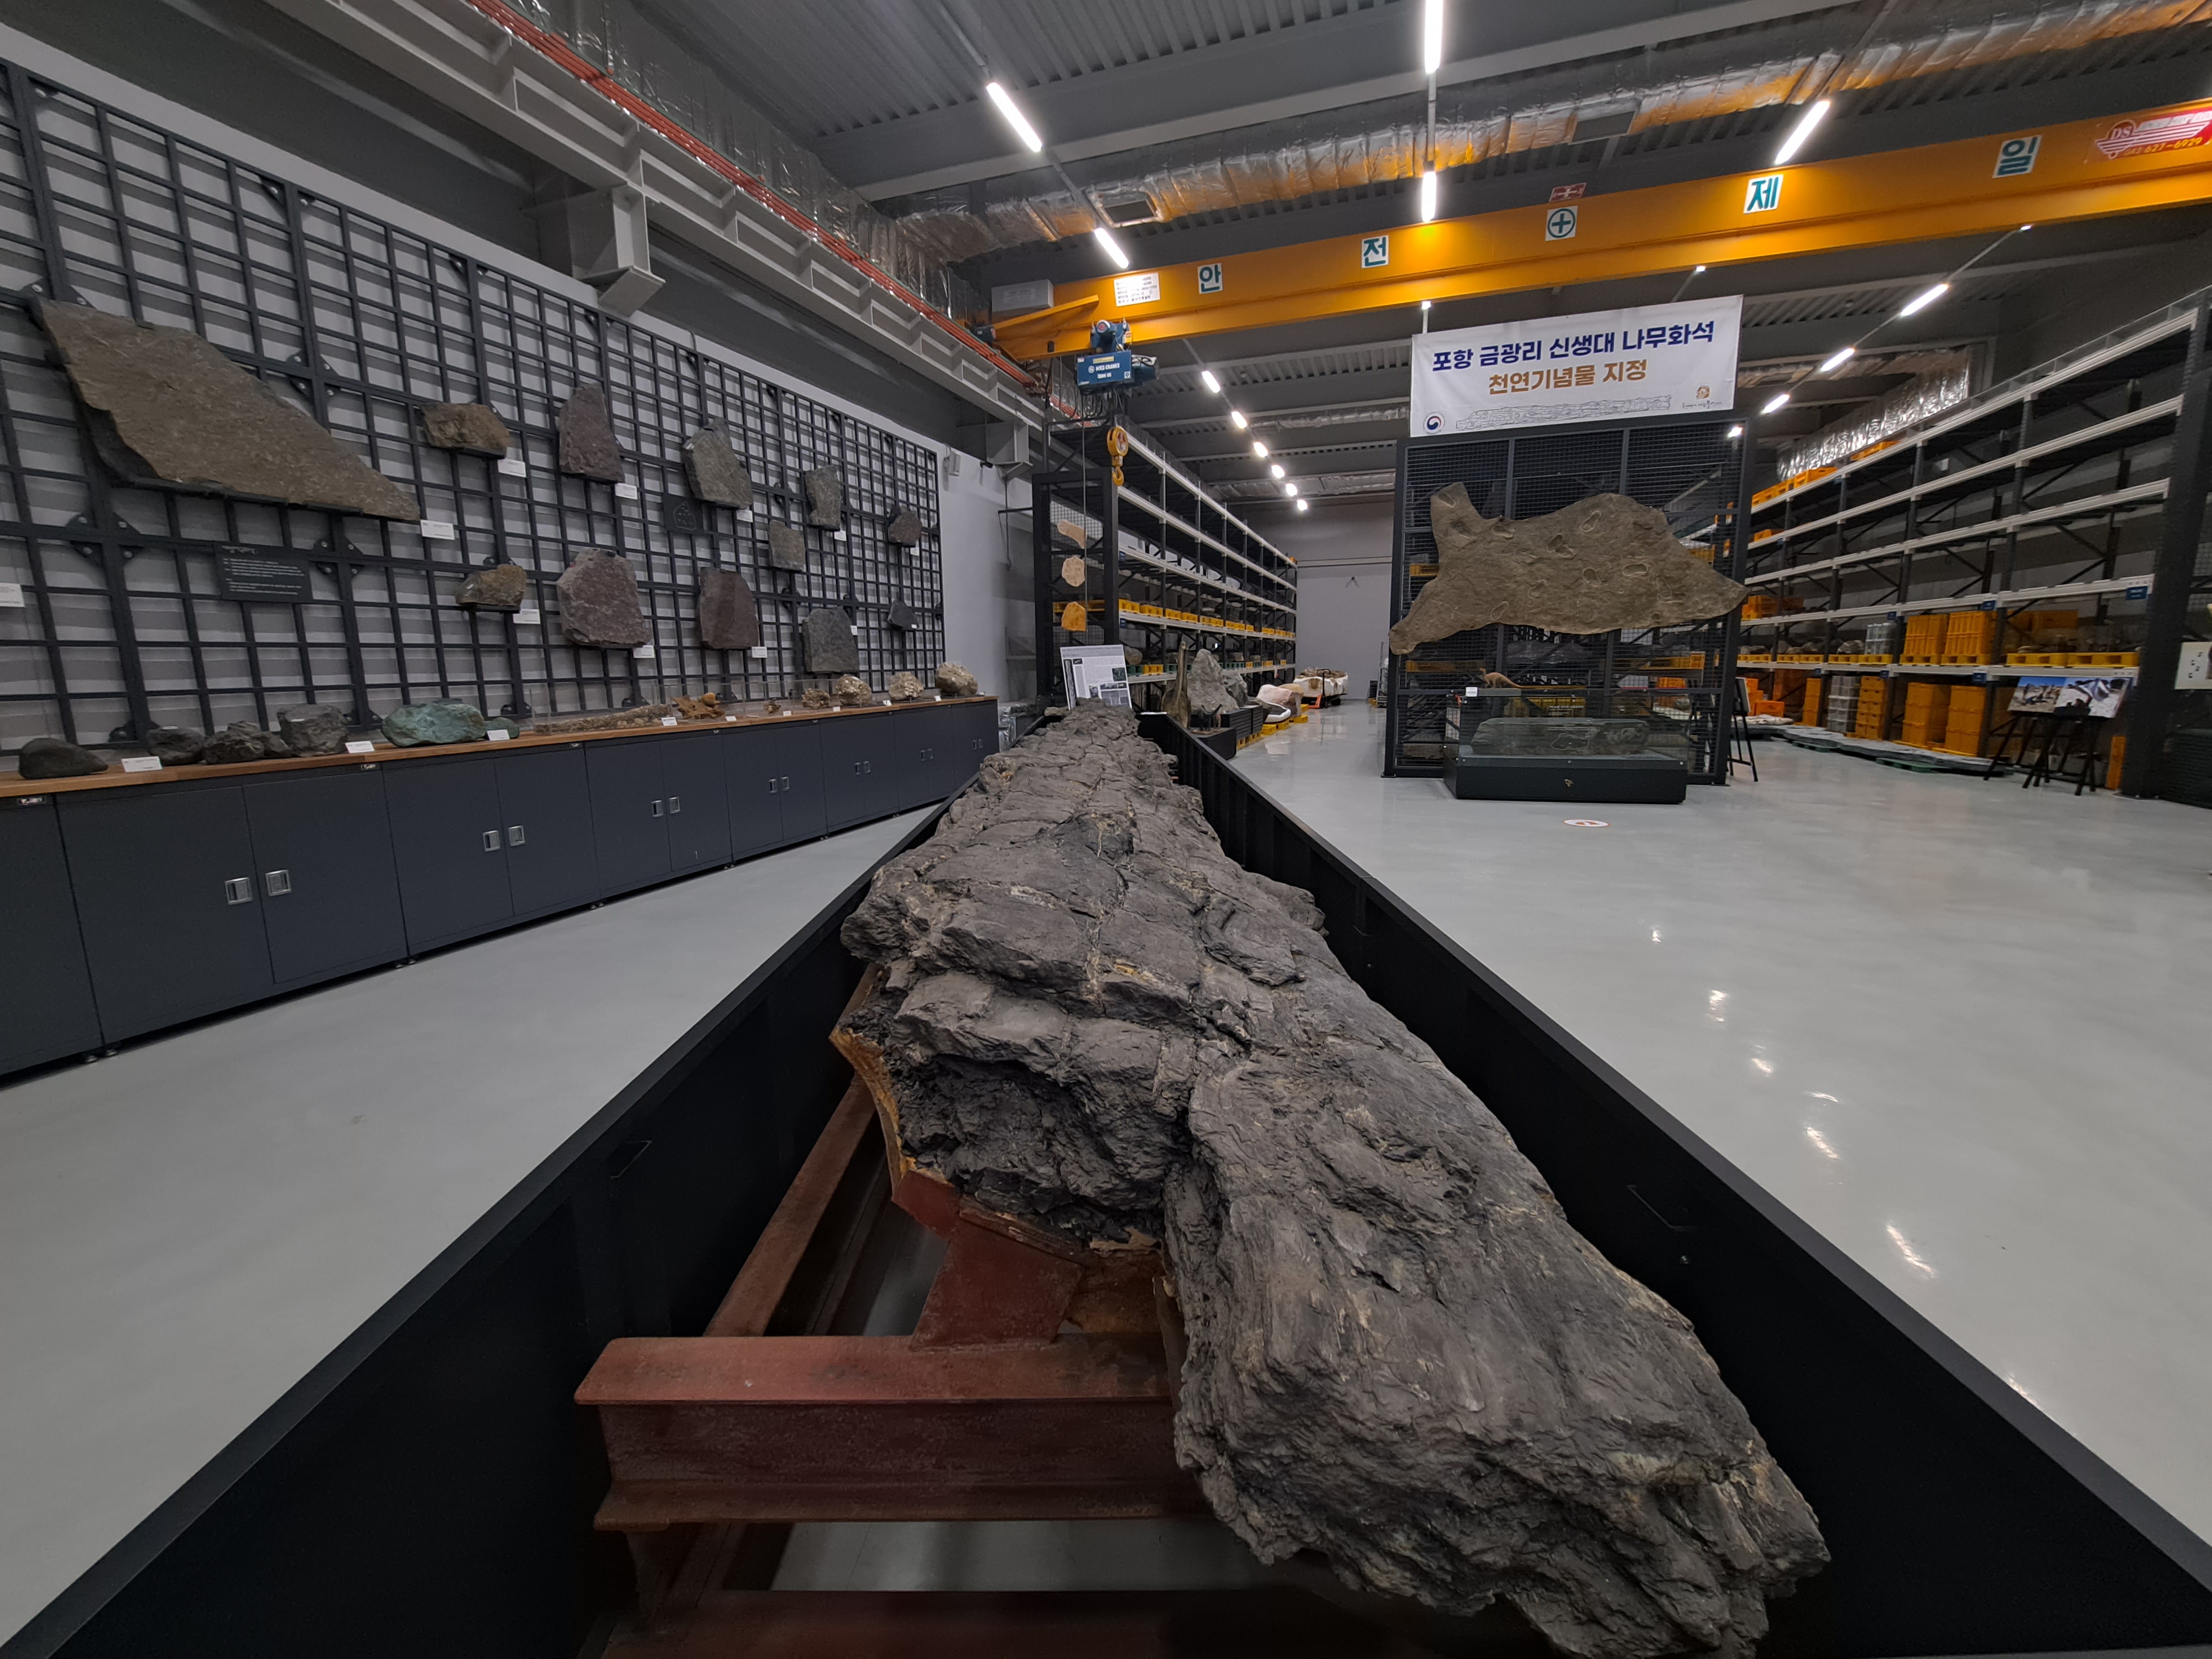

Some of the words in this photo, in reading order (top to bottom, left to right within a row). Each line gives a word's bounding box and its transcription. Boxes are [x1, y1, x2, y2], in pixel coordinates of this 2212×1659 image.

[2111, 127, 2133, 139] DS
[1199, 264, 1221, 293] 안
[1363, 237, 1387, 267] 전
[1746, 176, 1780, 212] 제
[1997, 136, 2038, 176] 일
[1432, 348, 1474, 372] 포항
[1479, 340, 1542, 367] 금광리
[1550, 332, 1615, 359] 신생대
[1623, 321, 1714, 350] 나무화석
[1489, 364, 1596, 395] 천연기념물
[1603, 359, 1647, 383] 지정
